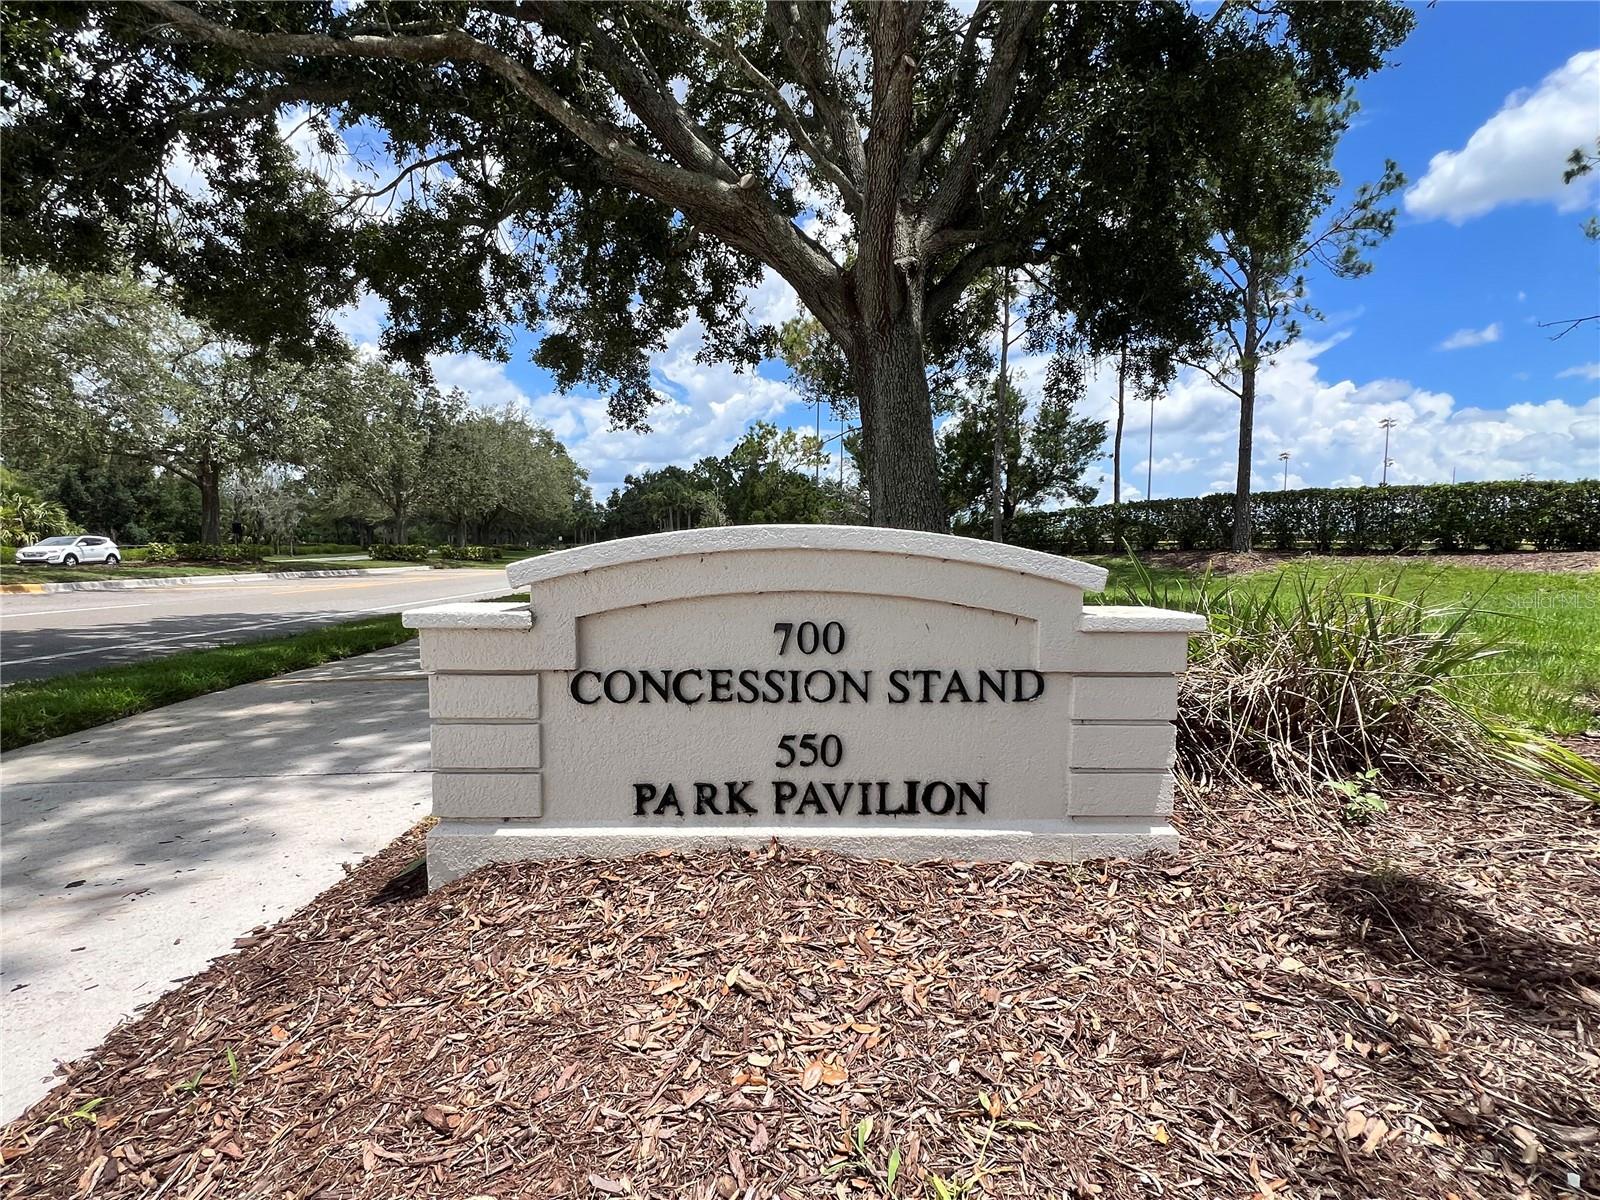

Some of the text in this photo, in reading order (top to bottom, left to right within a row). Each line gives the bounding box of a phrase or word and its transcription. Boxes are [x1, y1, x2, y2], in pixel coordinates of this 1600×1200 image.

[773, 621, 845, 655] 700
[570, 669, 1046, 704] CONCESSION STAND
[775, 733, 843, 768] 550
[632, 780, 989, 816] PARK PAVILION
